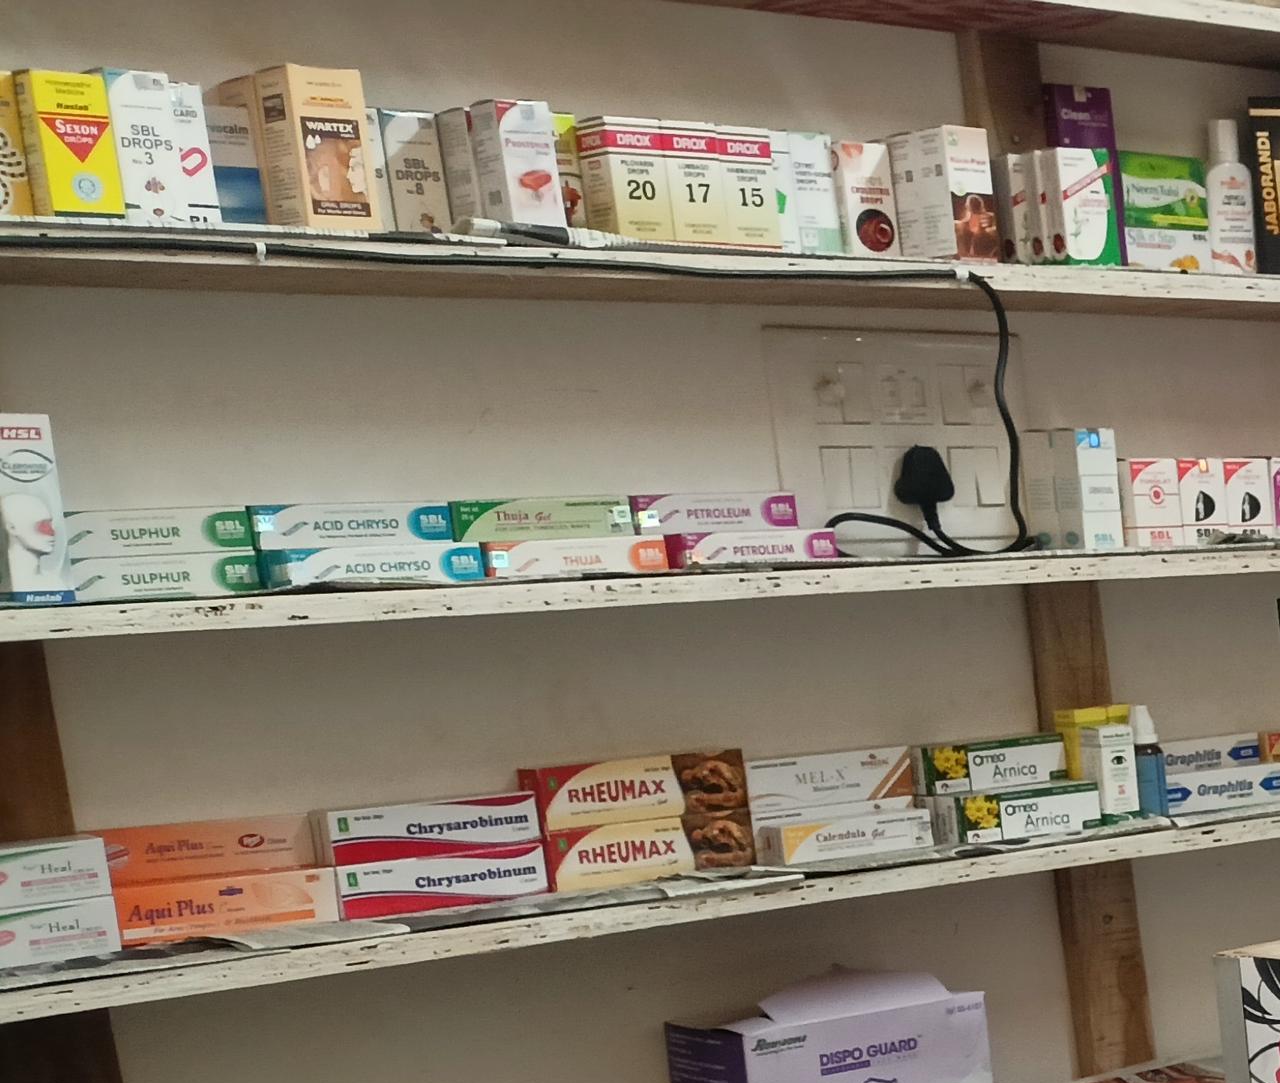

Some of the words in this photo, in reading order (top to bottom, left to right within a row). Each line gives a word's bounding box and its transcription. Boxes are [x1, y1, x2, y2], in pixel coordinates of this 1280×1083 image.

[130, 124, 159, 137] SBL
[121, 136, 173, 151] DROPS
[617, 134, 651, 147] DROX
[673, 137, 707, 151] DROX
[727, 142, 759, 155] DROX
[145, 151, 154, 165] 3
[403, 157, 429, 169] SBL
[396, 171, 441, 182] DROPS
[1256, 131, 1280, 234] JABORANDI
[416, 182, 424, 195] 8
[627, 180, 656, 201] 20
[685, 183, 710, 203] 17
[739, 188, 764, 207] 15
[494, 511, 529, 523] Thuja
[686, 508, 752, 519] PETROLEUM
[313, 519, 344, 531] ACID
[347, 518, 399, 530] CHRYSO
[111, 527, 181, 540] SULPHUR
[1150, 531, 1172, 540] SBL
[732, 545, 795, 555] PETROLEUM
[345, 563, 376, 574] ACID
[380, 560, 431, 573] CHRYSO
[562, 555, 602, 566] THUJA
[121, 571, 191, 585] SULPHUR
[972, 753, 1006, 767] Omeo
[992, 762, 1037, 779] Arnica
[567, 779, 666, 803] RHEUMAX
[1004, 802, 1039, 816] Omeo
[406, 813, 529, 835] Chrysarobinum
[1024, 811, 1070, 829] Arnica
[816, 829, 867, 844] Calendula
[578, 840, 676, 864] RHEUMAX
[40, 861, 72, 873] Heal
[415, 864, 537, 889] Chrysarobinum
[127, 902, 172, 925] Aqui
[176, 900, 215, 917] Plus
[49, 919, 80, 933] Heal
[819, 1047, 864, 1067] DISPO
[866, 1037, 918, 1059] GUARD
